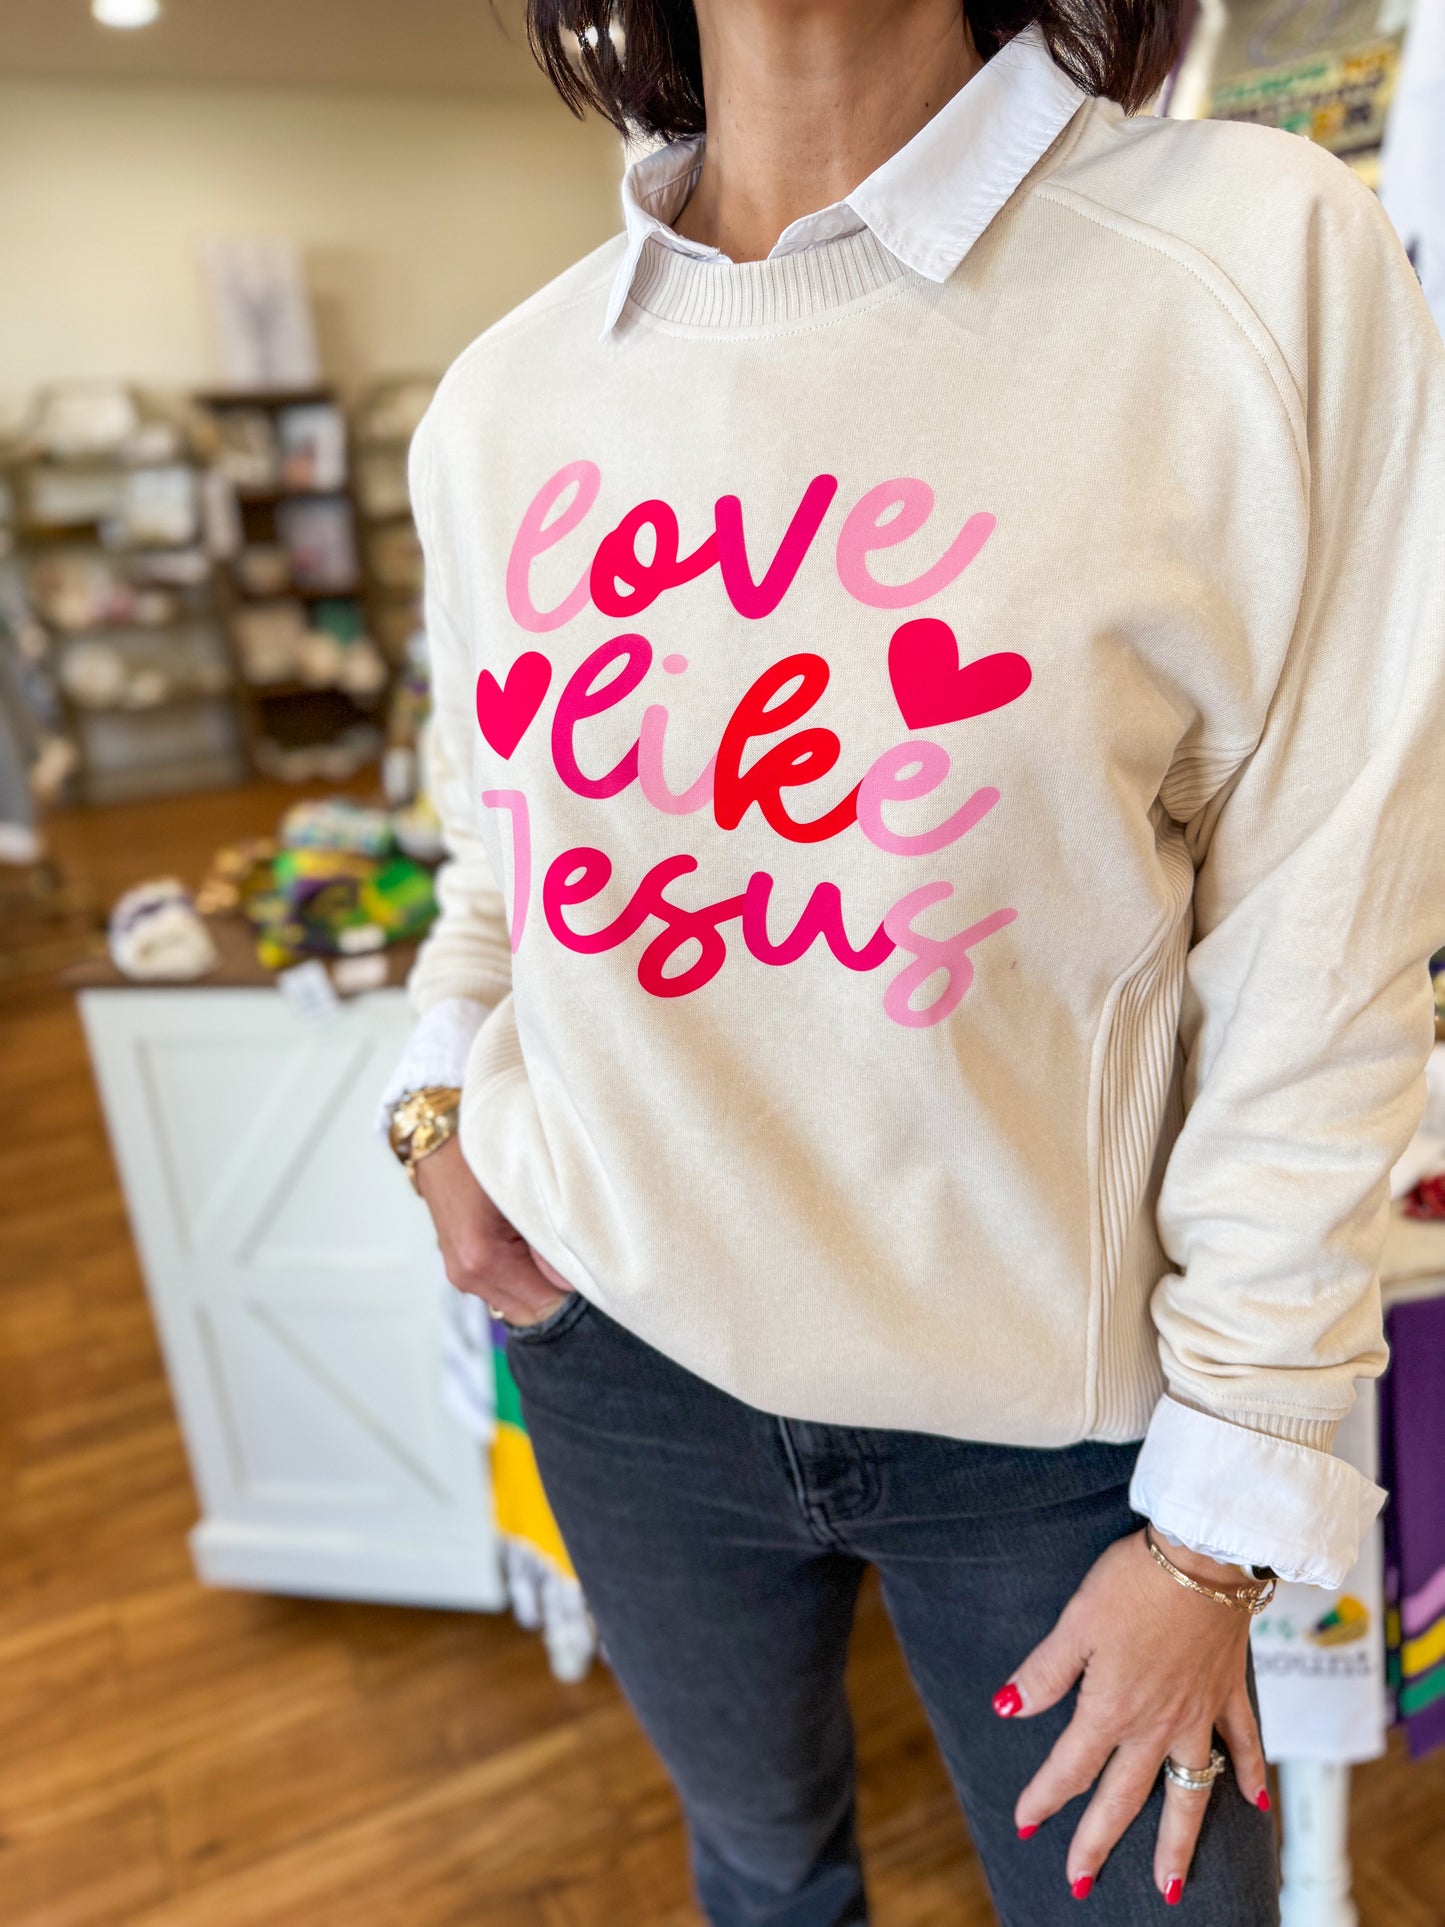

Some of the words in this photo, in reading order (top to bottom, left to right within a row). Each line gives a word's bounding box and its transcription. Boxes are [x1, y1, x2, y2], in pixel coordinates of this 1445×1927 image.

[506, 459, 996, 633] love
[551, 633, 1001, 857] like
[482, 790, 1018, 1028] Jesus
